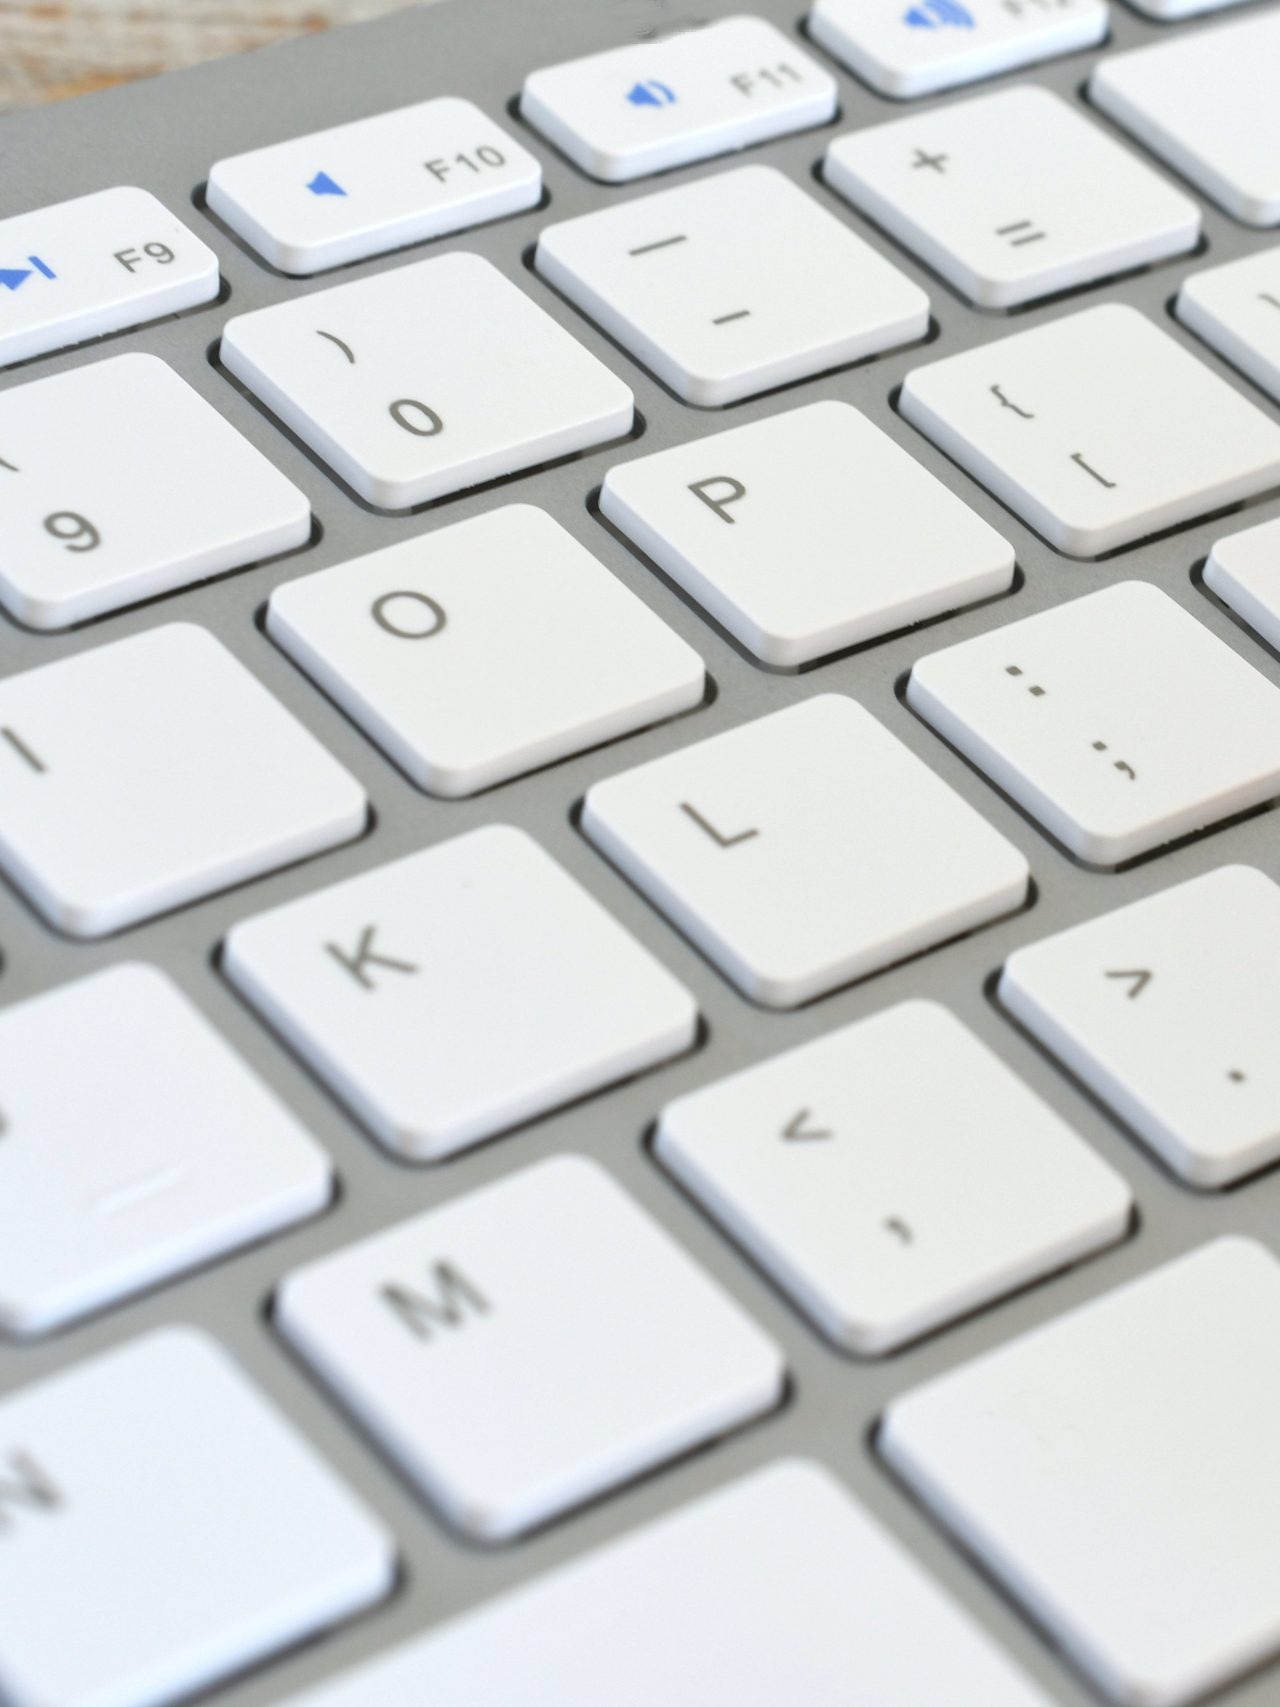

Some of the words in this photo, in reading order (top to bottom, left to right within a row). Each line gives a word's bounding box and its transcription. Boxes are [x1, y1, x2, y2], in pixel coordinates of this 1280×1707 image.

[730, 64, 801, 97] F11
[424, 146, 506, 182] F10
[114, 243, 175, 273] F9
[389, 399, 443, 437] 0
[688, 476, 746, 524] P
[43, 511, 101, 553] 9
[371, 591, 447, 640] O
[680, 803, 758, 848] L
[325, 926, 416, 990] K
[380, 1261, 488, 1338] M
